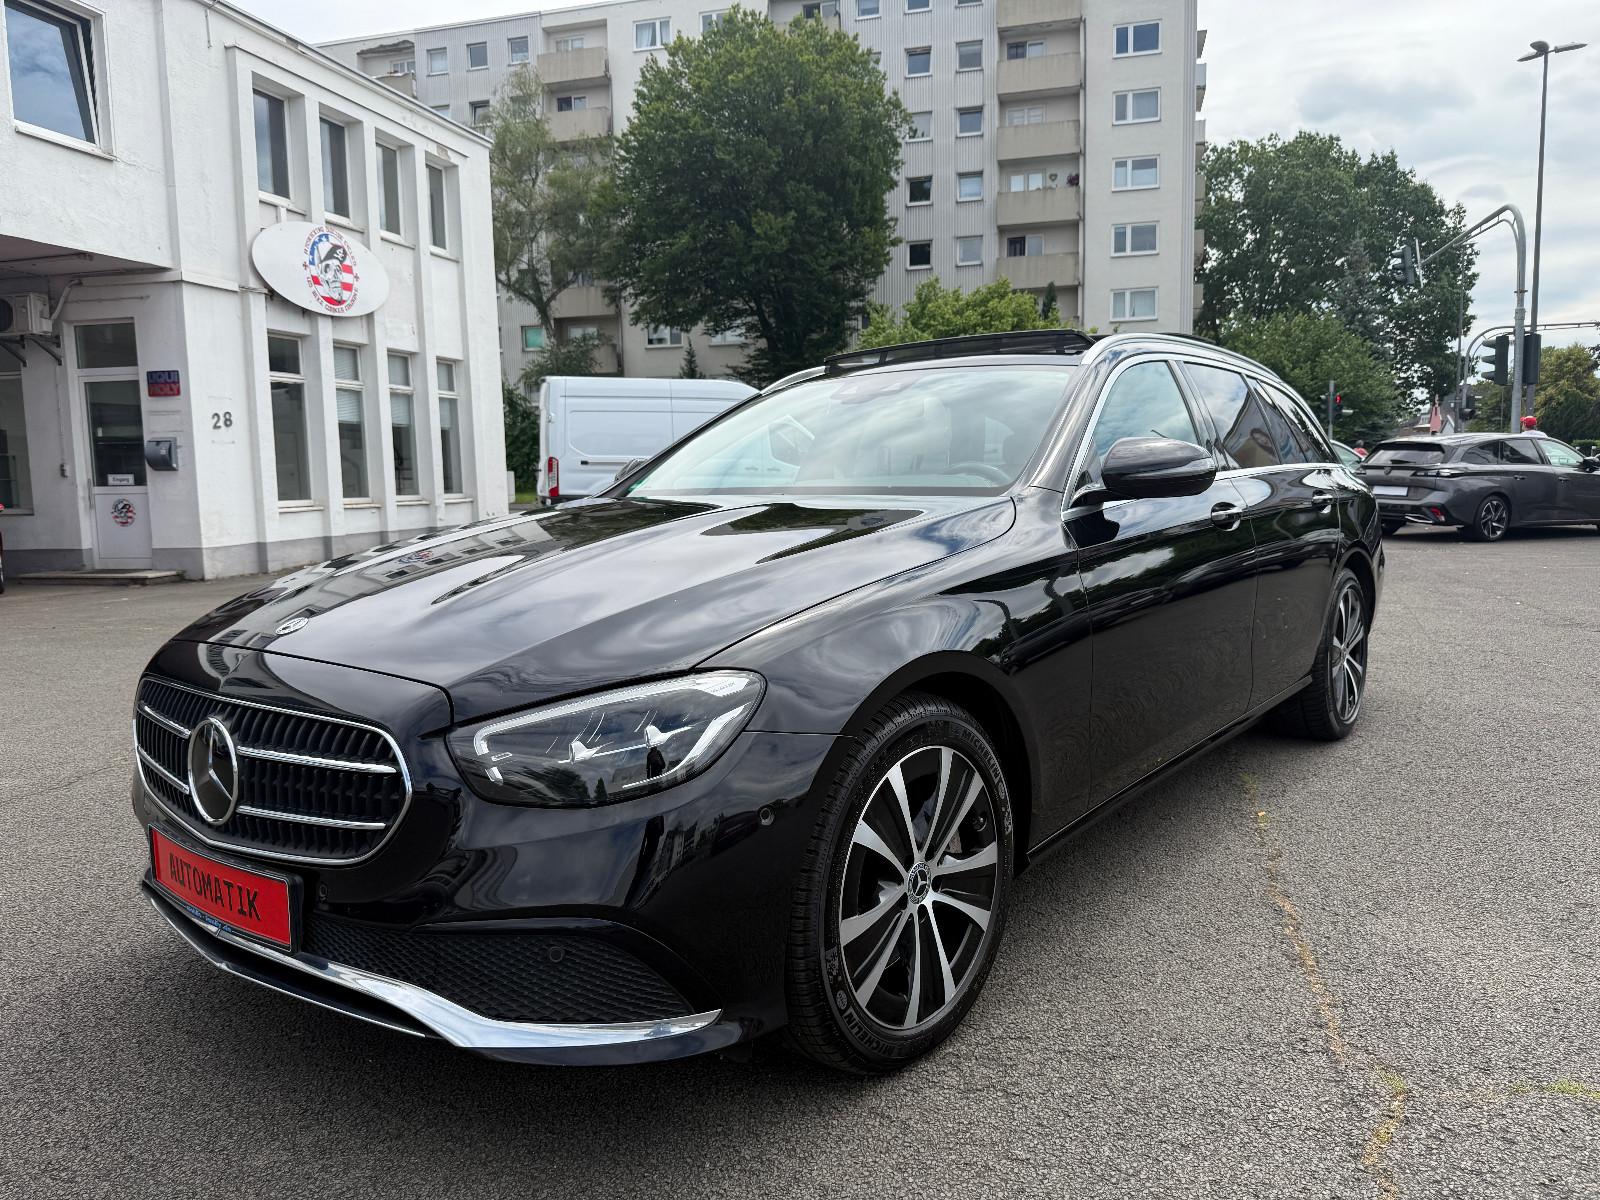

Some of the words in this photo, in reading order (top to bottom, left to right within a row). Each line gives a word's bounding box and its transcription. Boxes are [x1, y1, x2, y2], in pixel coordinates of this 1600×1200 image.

[148, 371, 179, 384] LIQUI
[149, 383, 180, 396] MOLY
[211, 411, 233, 430] 28
[169, 852, 261, 921] AUTOMATIK
